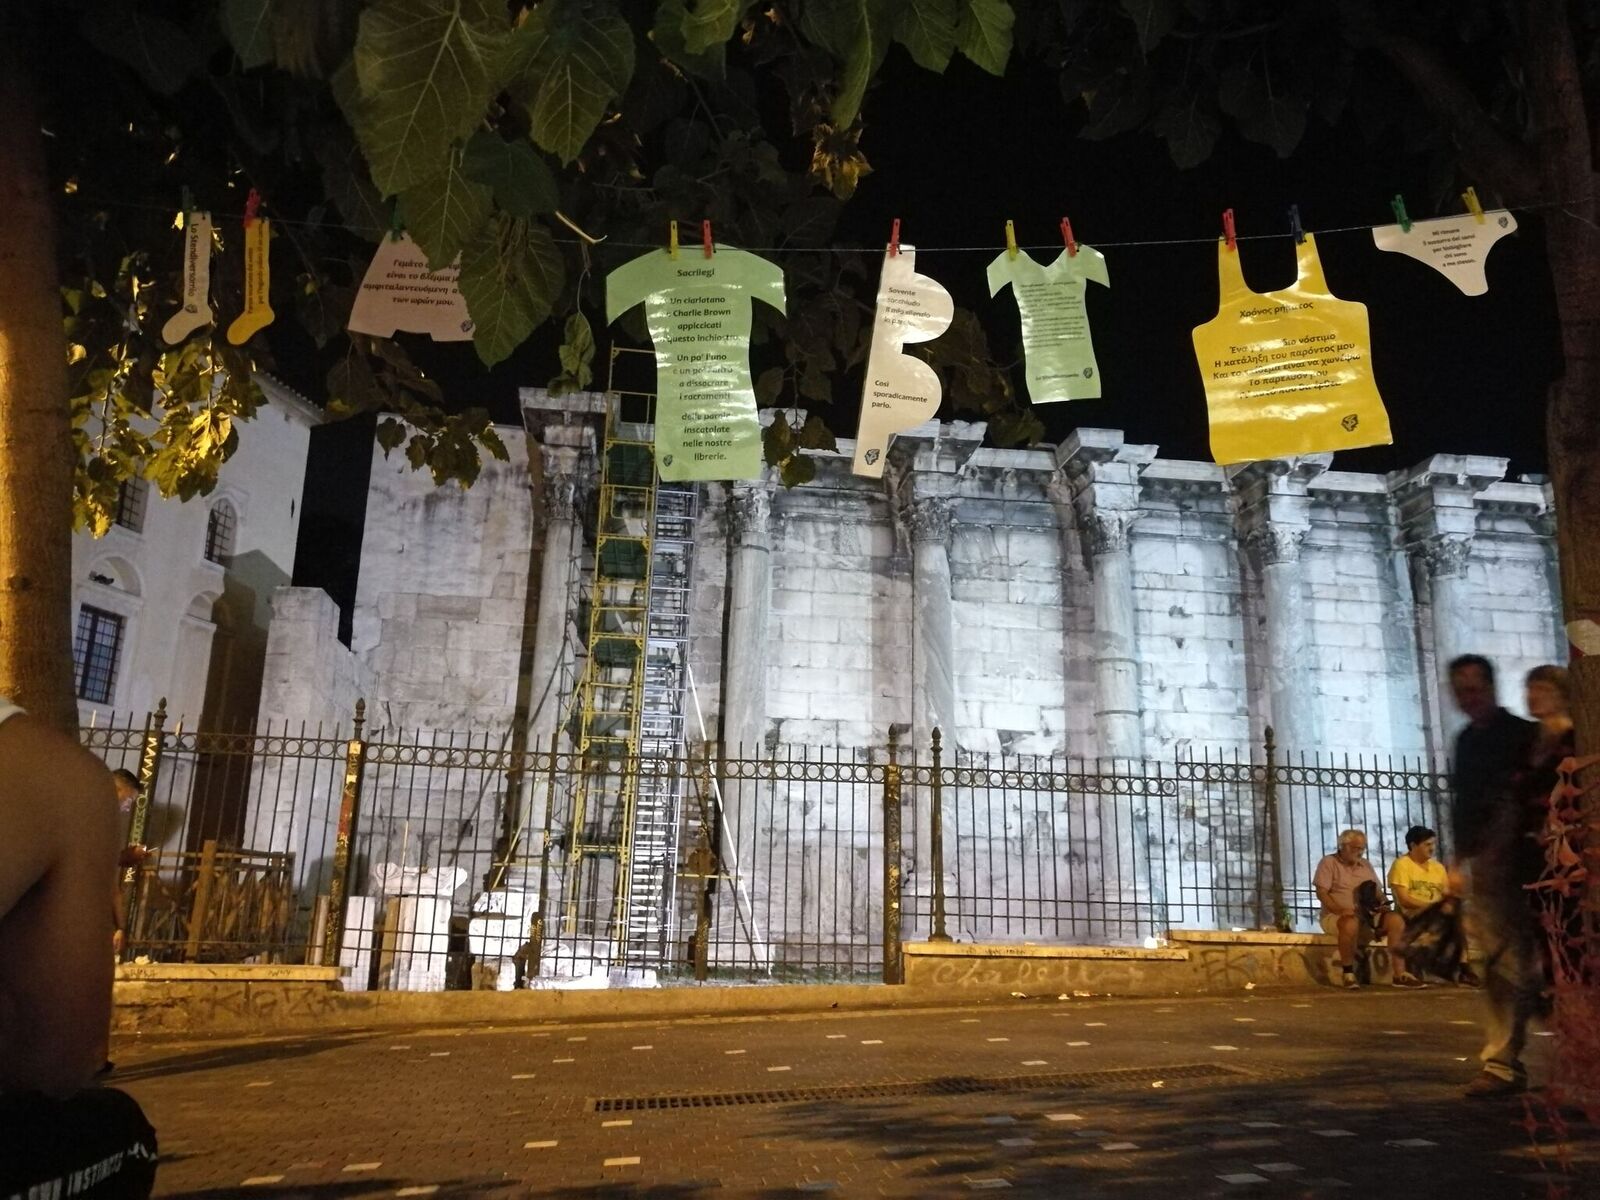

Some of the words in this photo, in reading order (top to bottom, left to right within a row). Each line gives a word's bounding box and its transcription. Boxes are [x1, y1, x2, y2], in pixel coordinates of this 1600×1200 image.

[677, 269, 715, 278] Sacrilegi
[888, 287, 916, 296] Sovente
[673, 309, 702, 317] Charlie
[704, 308, 731, 316] Brown
[1273, 302, 1314, 315] ρήτος
[677, 322, 722, 331] appiccicati
[1299, 333, 1336, 344] νόστιμο
[690, 354, 704, 363] po'
[705, 353, 727, 361] l'uno
[1214, 360, 1221, 368] Η
[1270, 352, 1287, 361] του
[1290, 345, 1335, 358] παρόντος
[1336, 343, 1355, 353] μου
[873, 391, 928, 403] sporadicamente
[871, 401, 892, 409] parlo.
[684, 426, 730, 434] inscatolate
[694, 453, 727, 461] librerie.
